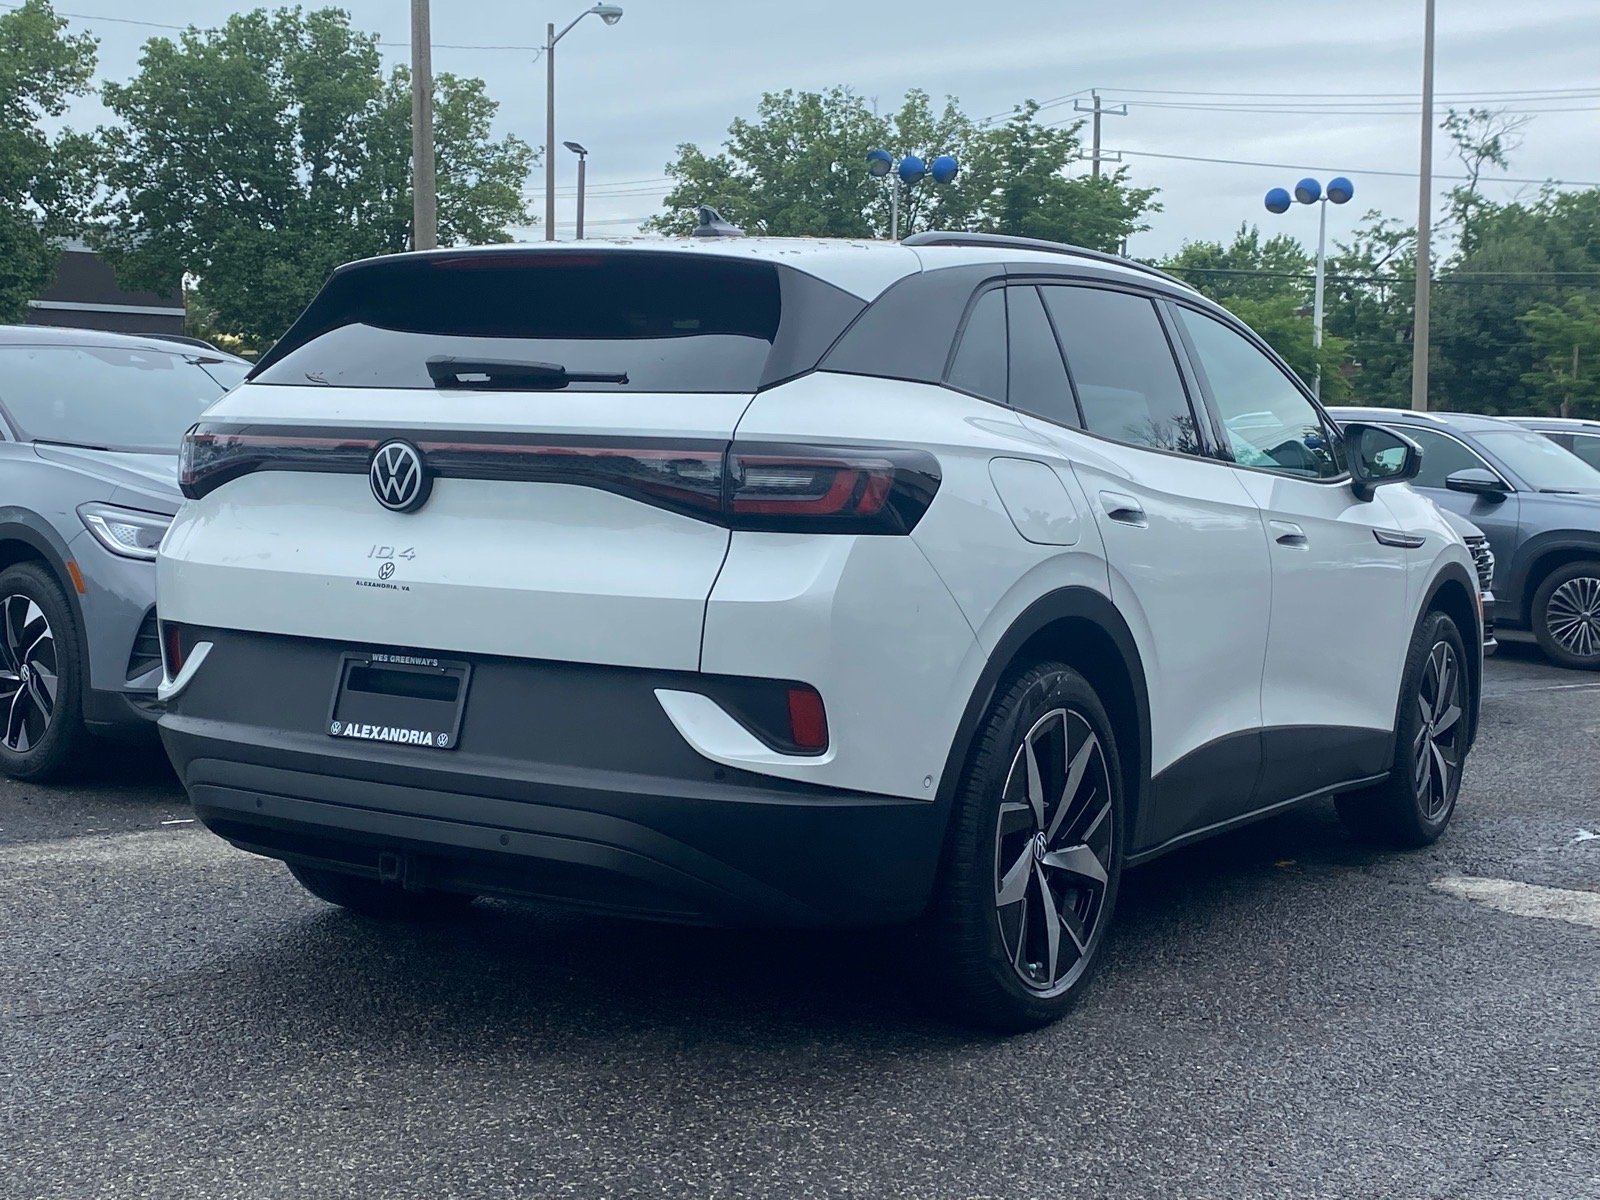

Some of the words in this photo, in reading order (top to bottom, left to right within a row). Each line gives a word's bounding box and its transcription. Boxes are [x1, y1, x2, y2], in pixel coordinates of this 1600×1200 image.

[372, 653, 388, 662] WES
[389, 655, 438, 667] GREENWAY'S
[343, 723, 433, 746] ALEXANDRIA
